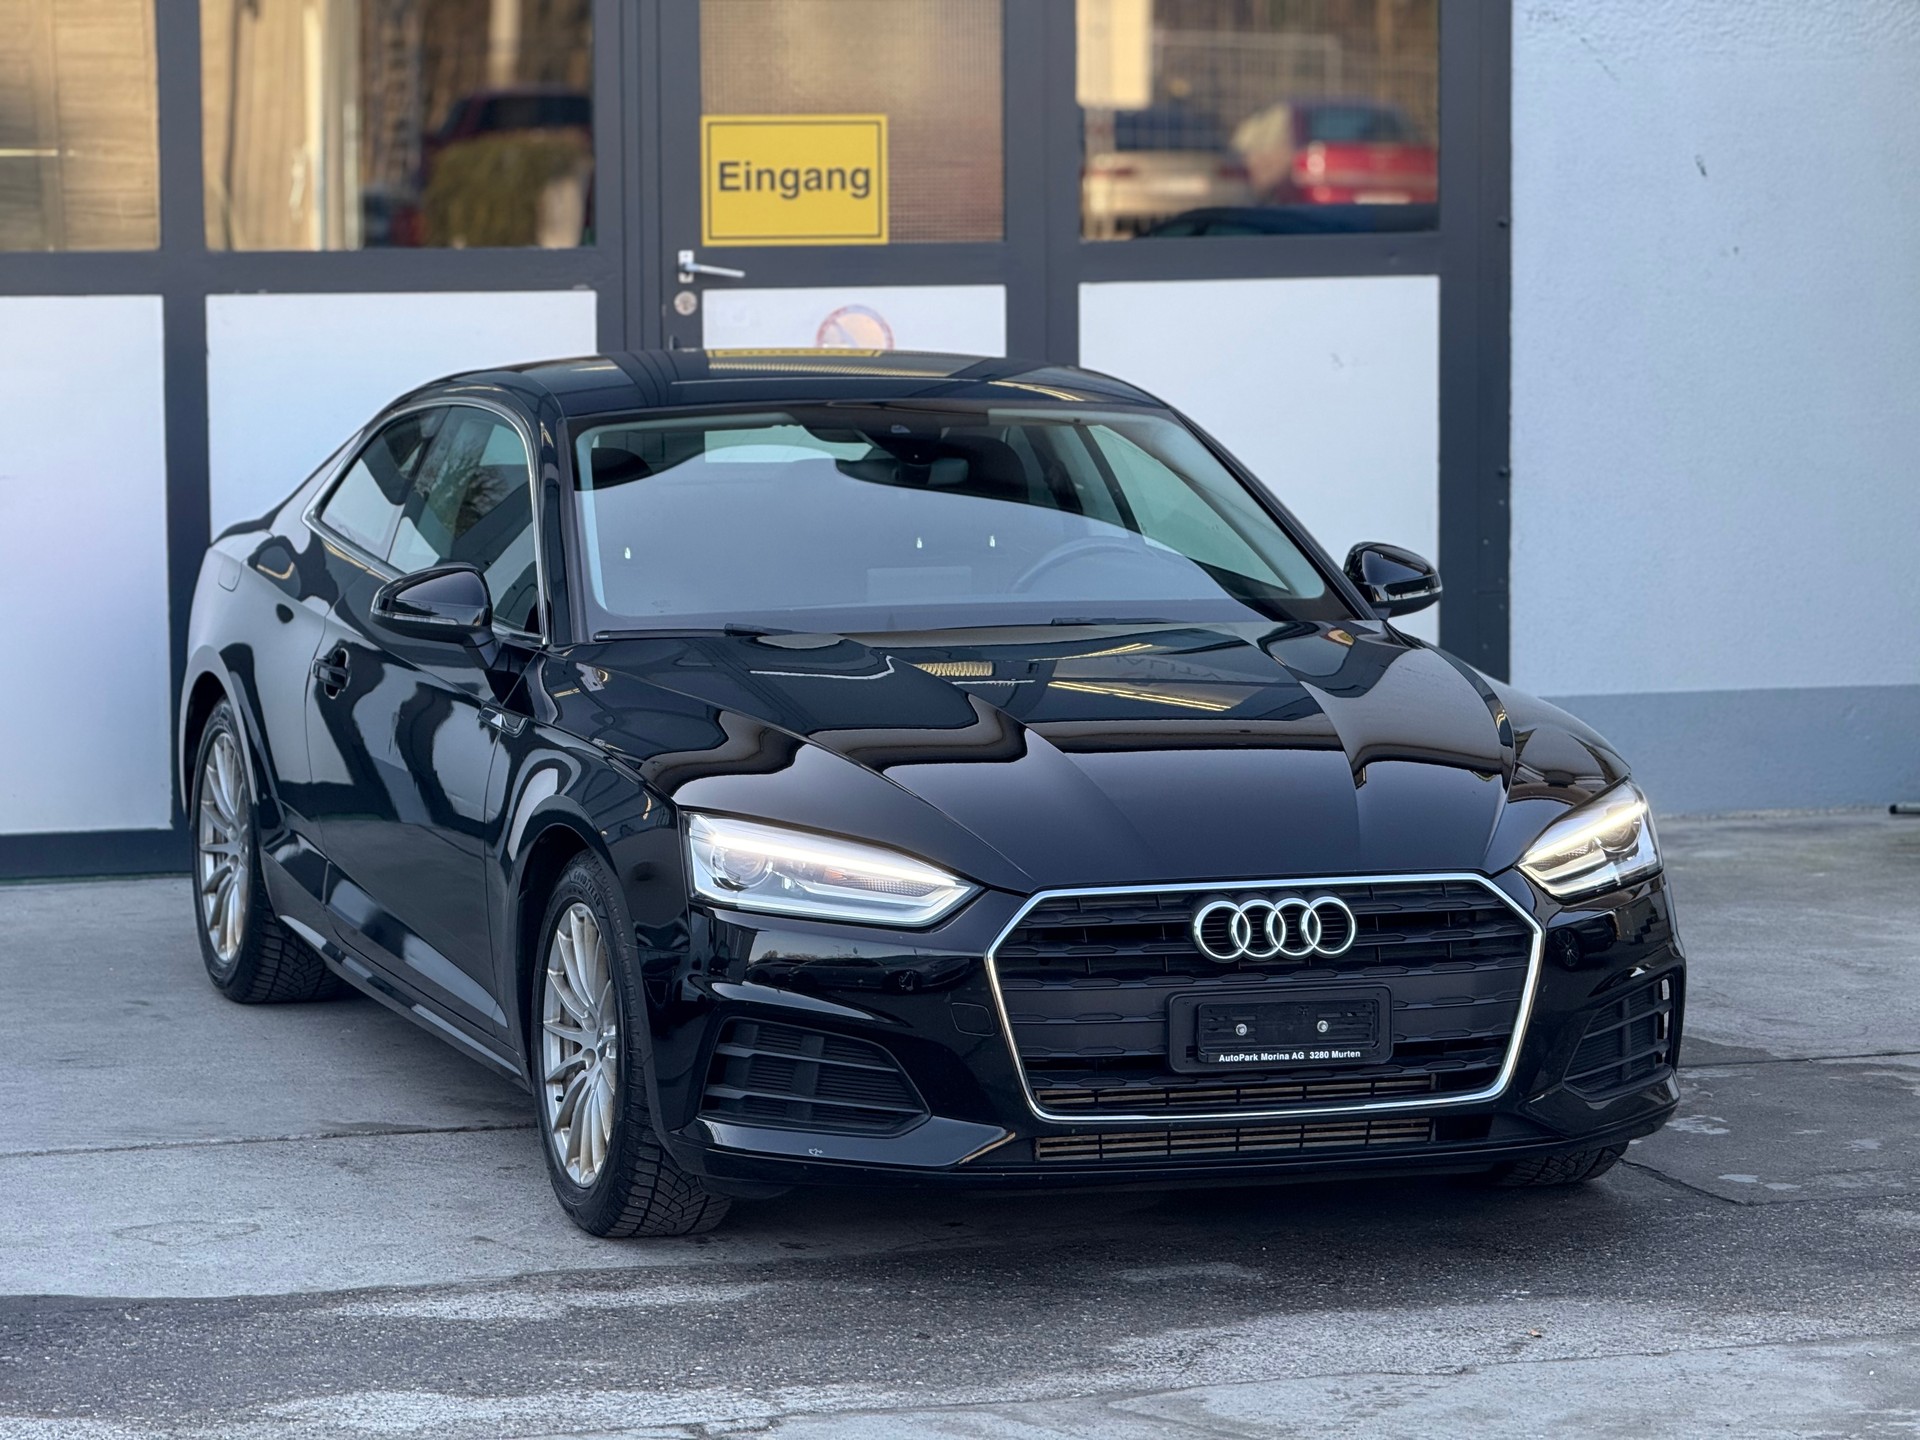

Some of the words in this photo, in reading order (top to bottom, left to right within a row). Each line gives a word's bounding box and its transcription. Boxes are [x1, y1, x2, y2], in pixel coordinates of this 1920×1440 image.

[718, 161, 871, 200] Eingang
[1218, 1053, 1259, 1062] AutoPark
[1260, 1053, 1289, 1061] Morina
[1291, 1052, 1305, 1060] AG
[1309, 1051, 1329, 1059] 3280
[1331, 1050, 1361, 1059] Murten
